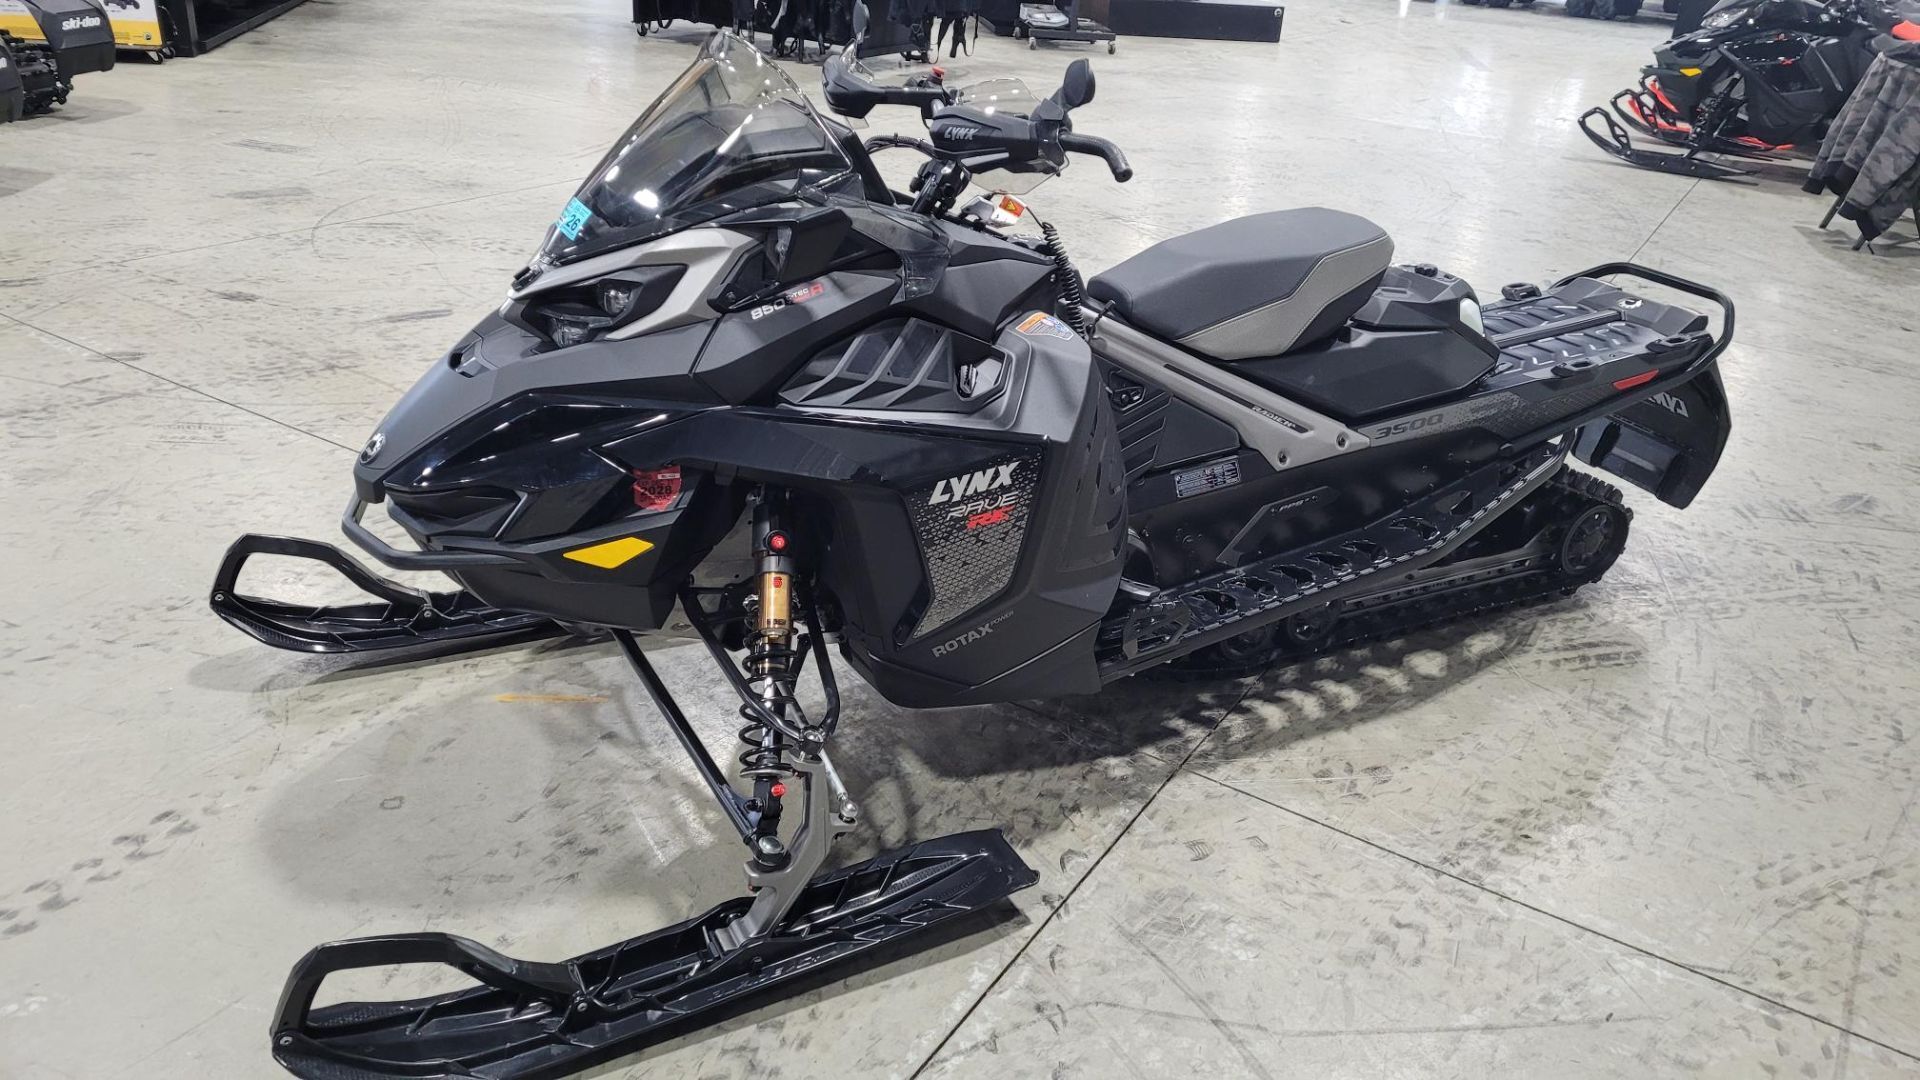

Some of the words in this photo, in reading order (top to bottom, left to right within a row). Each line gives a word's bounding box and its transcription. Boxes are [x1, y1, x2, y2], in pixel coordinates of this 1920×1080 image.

[62, 16, 100, 31] ski-doo
[944, 126, 979, 141] LYNX
[566, 213, 581, 231] 26
[750, 298, 786, 320] 850
[1374, 413, 1444, 439] 3500
[640, 484, 673, 496] 2028
[928, 460, 1020, 506] LYNX
[946, 491, 1020, 521] RAVE
[932, 622, 994, 658] ROTAX
